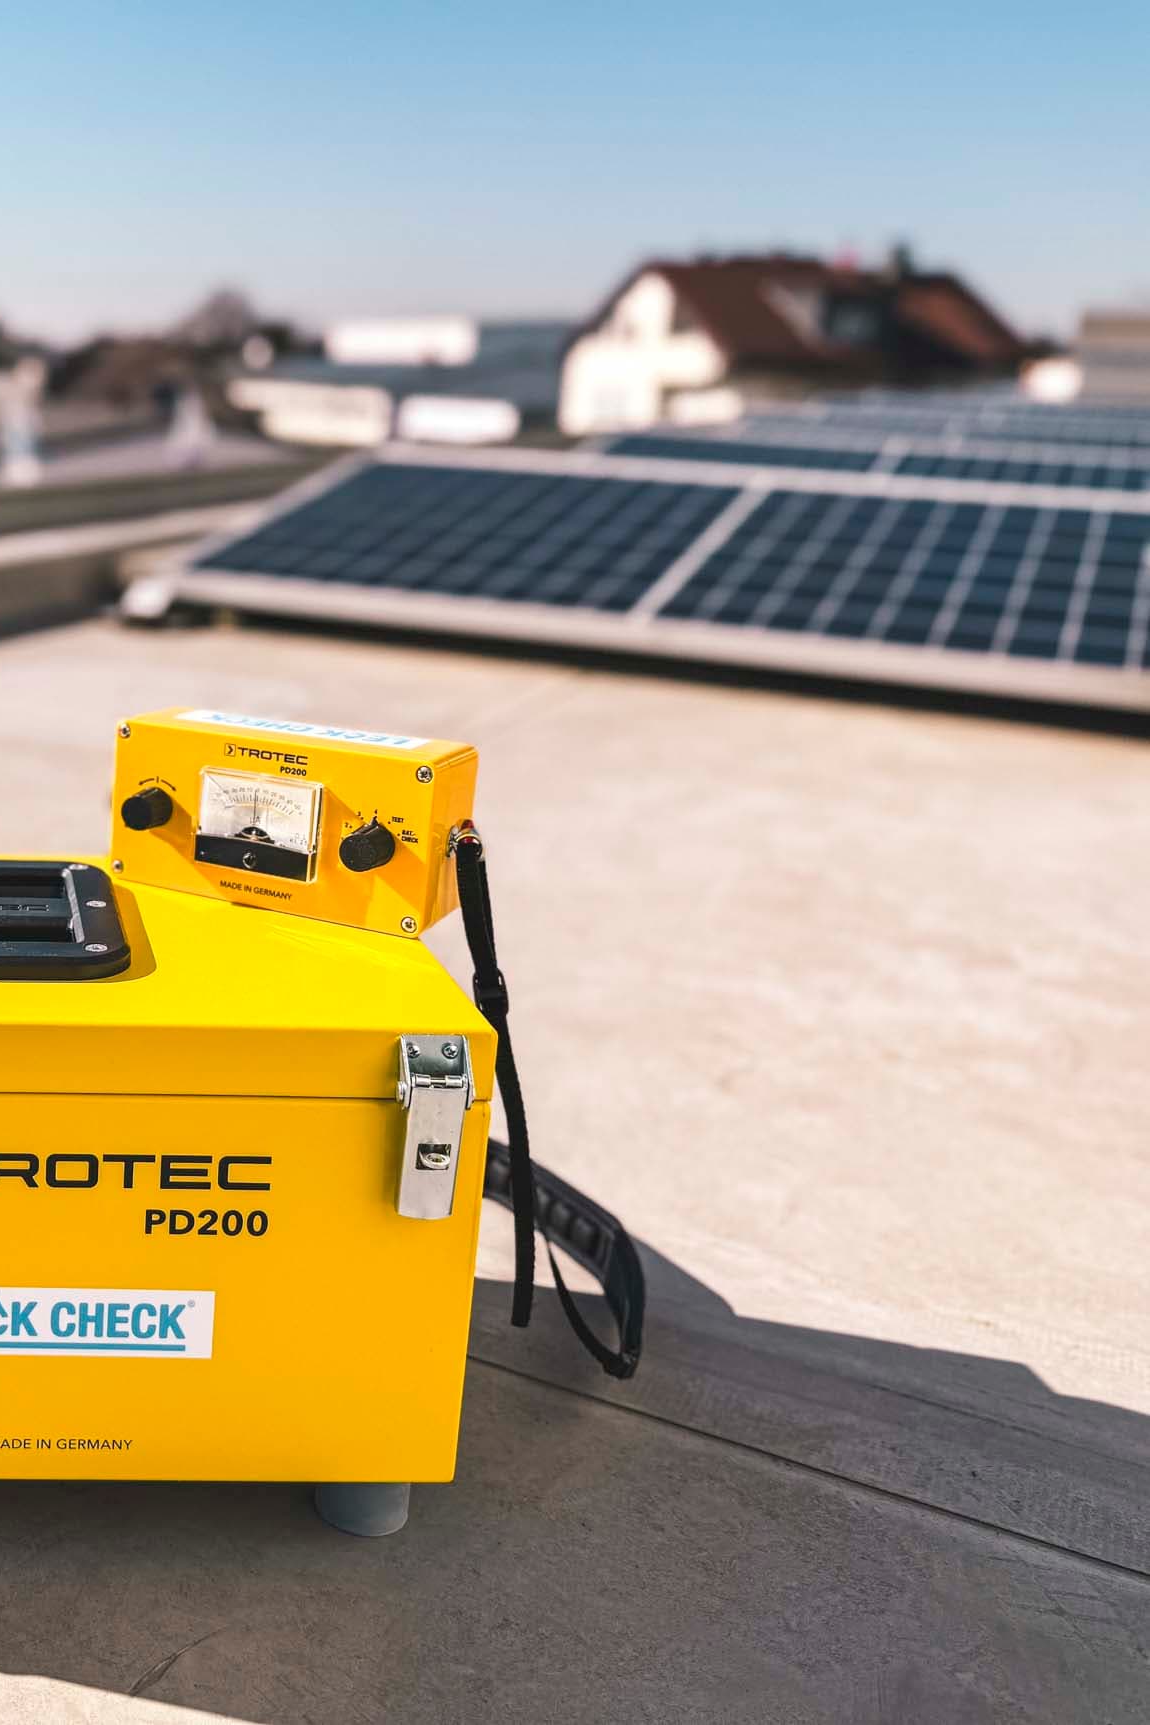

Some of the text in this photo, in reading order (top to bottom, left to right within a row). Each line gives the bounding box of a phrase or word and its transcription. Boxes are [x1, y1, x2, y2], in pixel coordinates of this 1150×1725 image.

[237, 747, 308, 765] TROTEC
[280, 766, 307, 777] PD200
[220, 880, 292, 900] MADE IN GERMANY
[145, 1210, 269, 1236] PD200
[37, 1438, 52, 1450] IN
[56, 1438, 133, 1450] GERMANY
